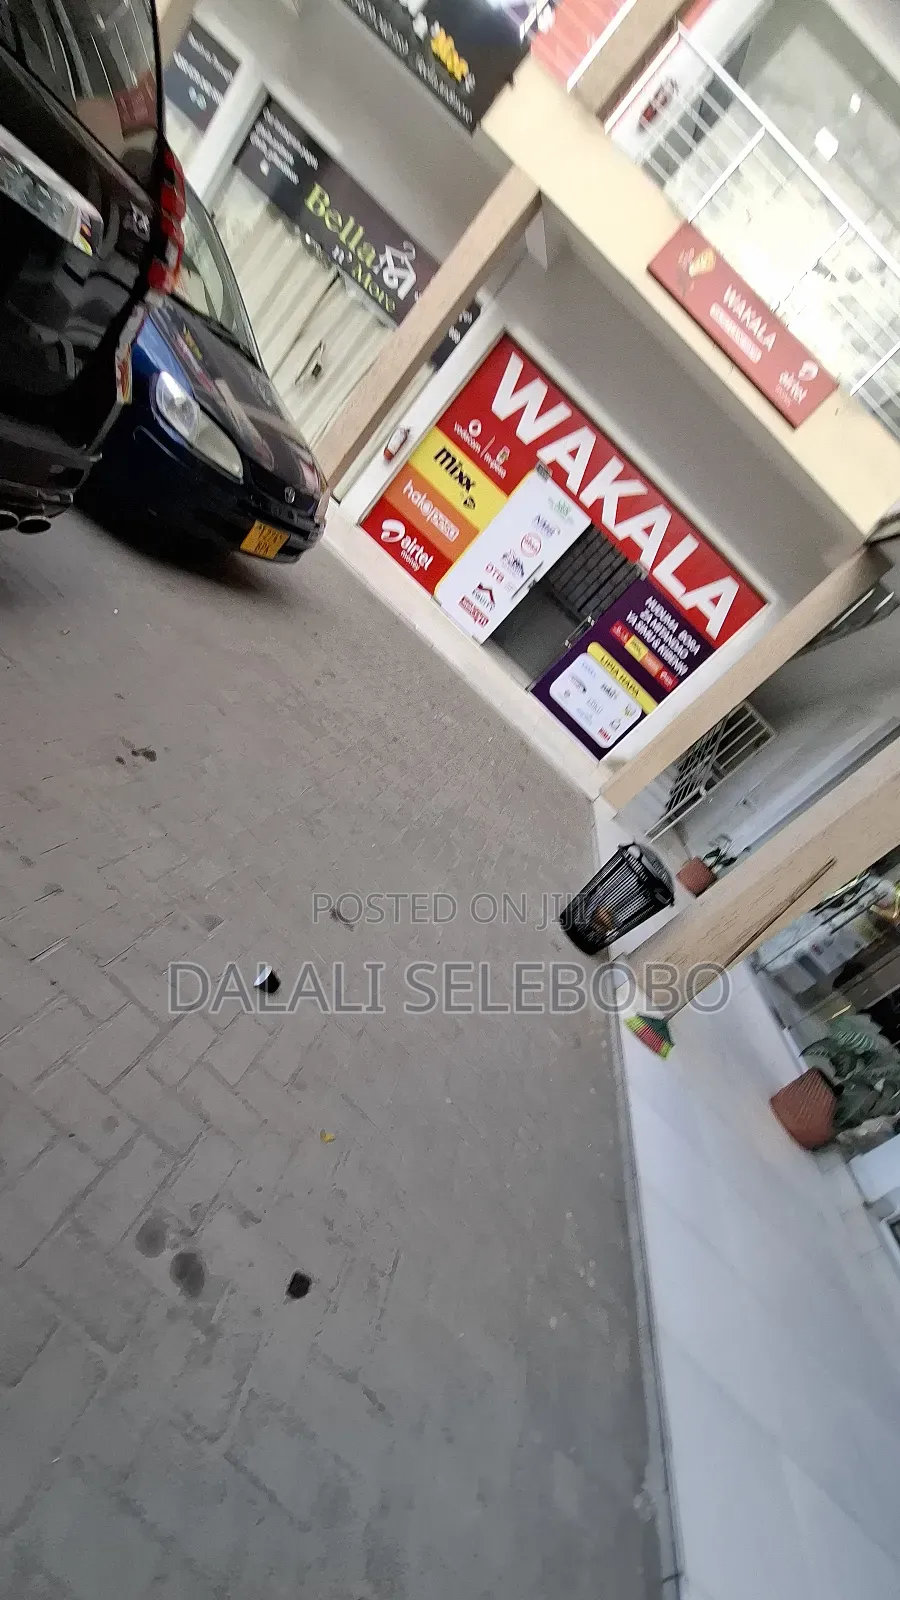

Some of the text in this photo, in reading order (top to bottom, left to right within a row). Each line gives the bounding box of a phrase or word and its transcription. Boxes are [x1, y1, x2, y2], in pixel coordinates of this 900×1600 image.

[304, 182, 376, 269] Bella
[351, 263, 396, 314] More
[723, 283, 777, 353] WAKALA
[491, 351, 740, 640] WAKALA
[400, 534, 434, 571] airtel
[400, 548, 421, 572] money
[634, 620, 658, 644] SIMU
[645, 595, 680, 635] HUDUMA
[677, 629, 701, 657] BORA
[619, 674, 640, 699] HAPA
